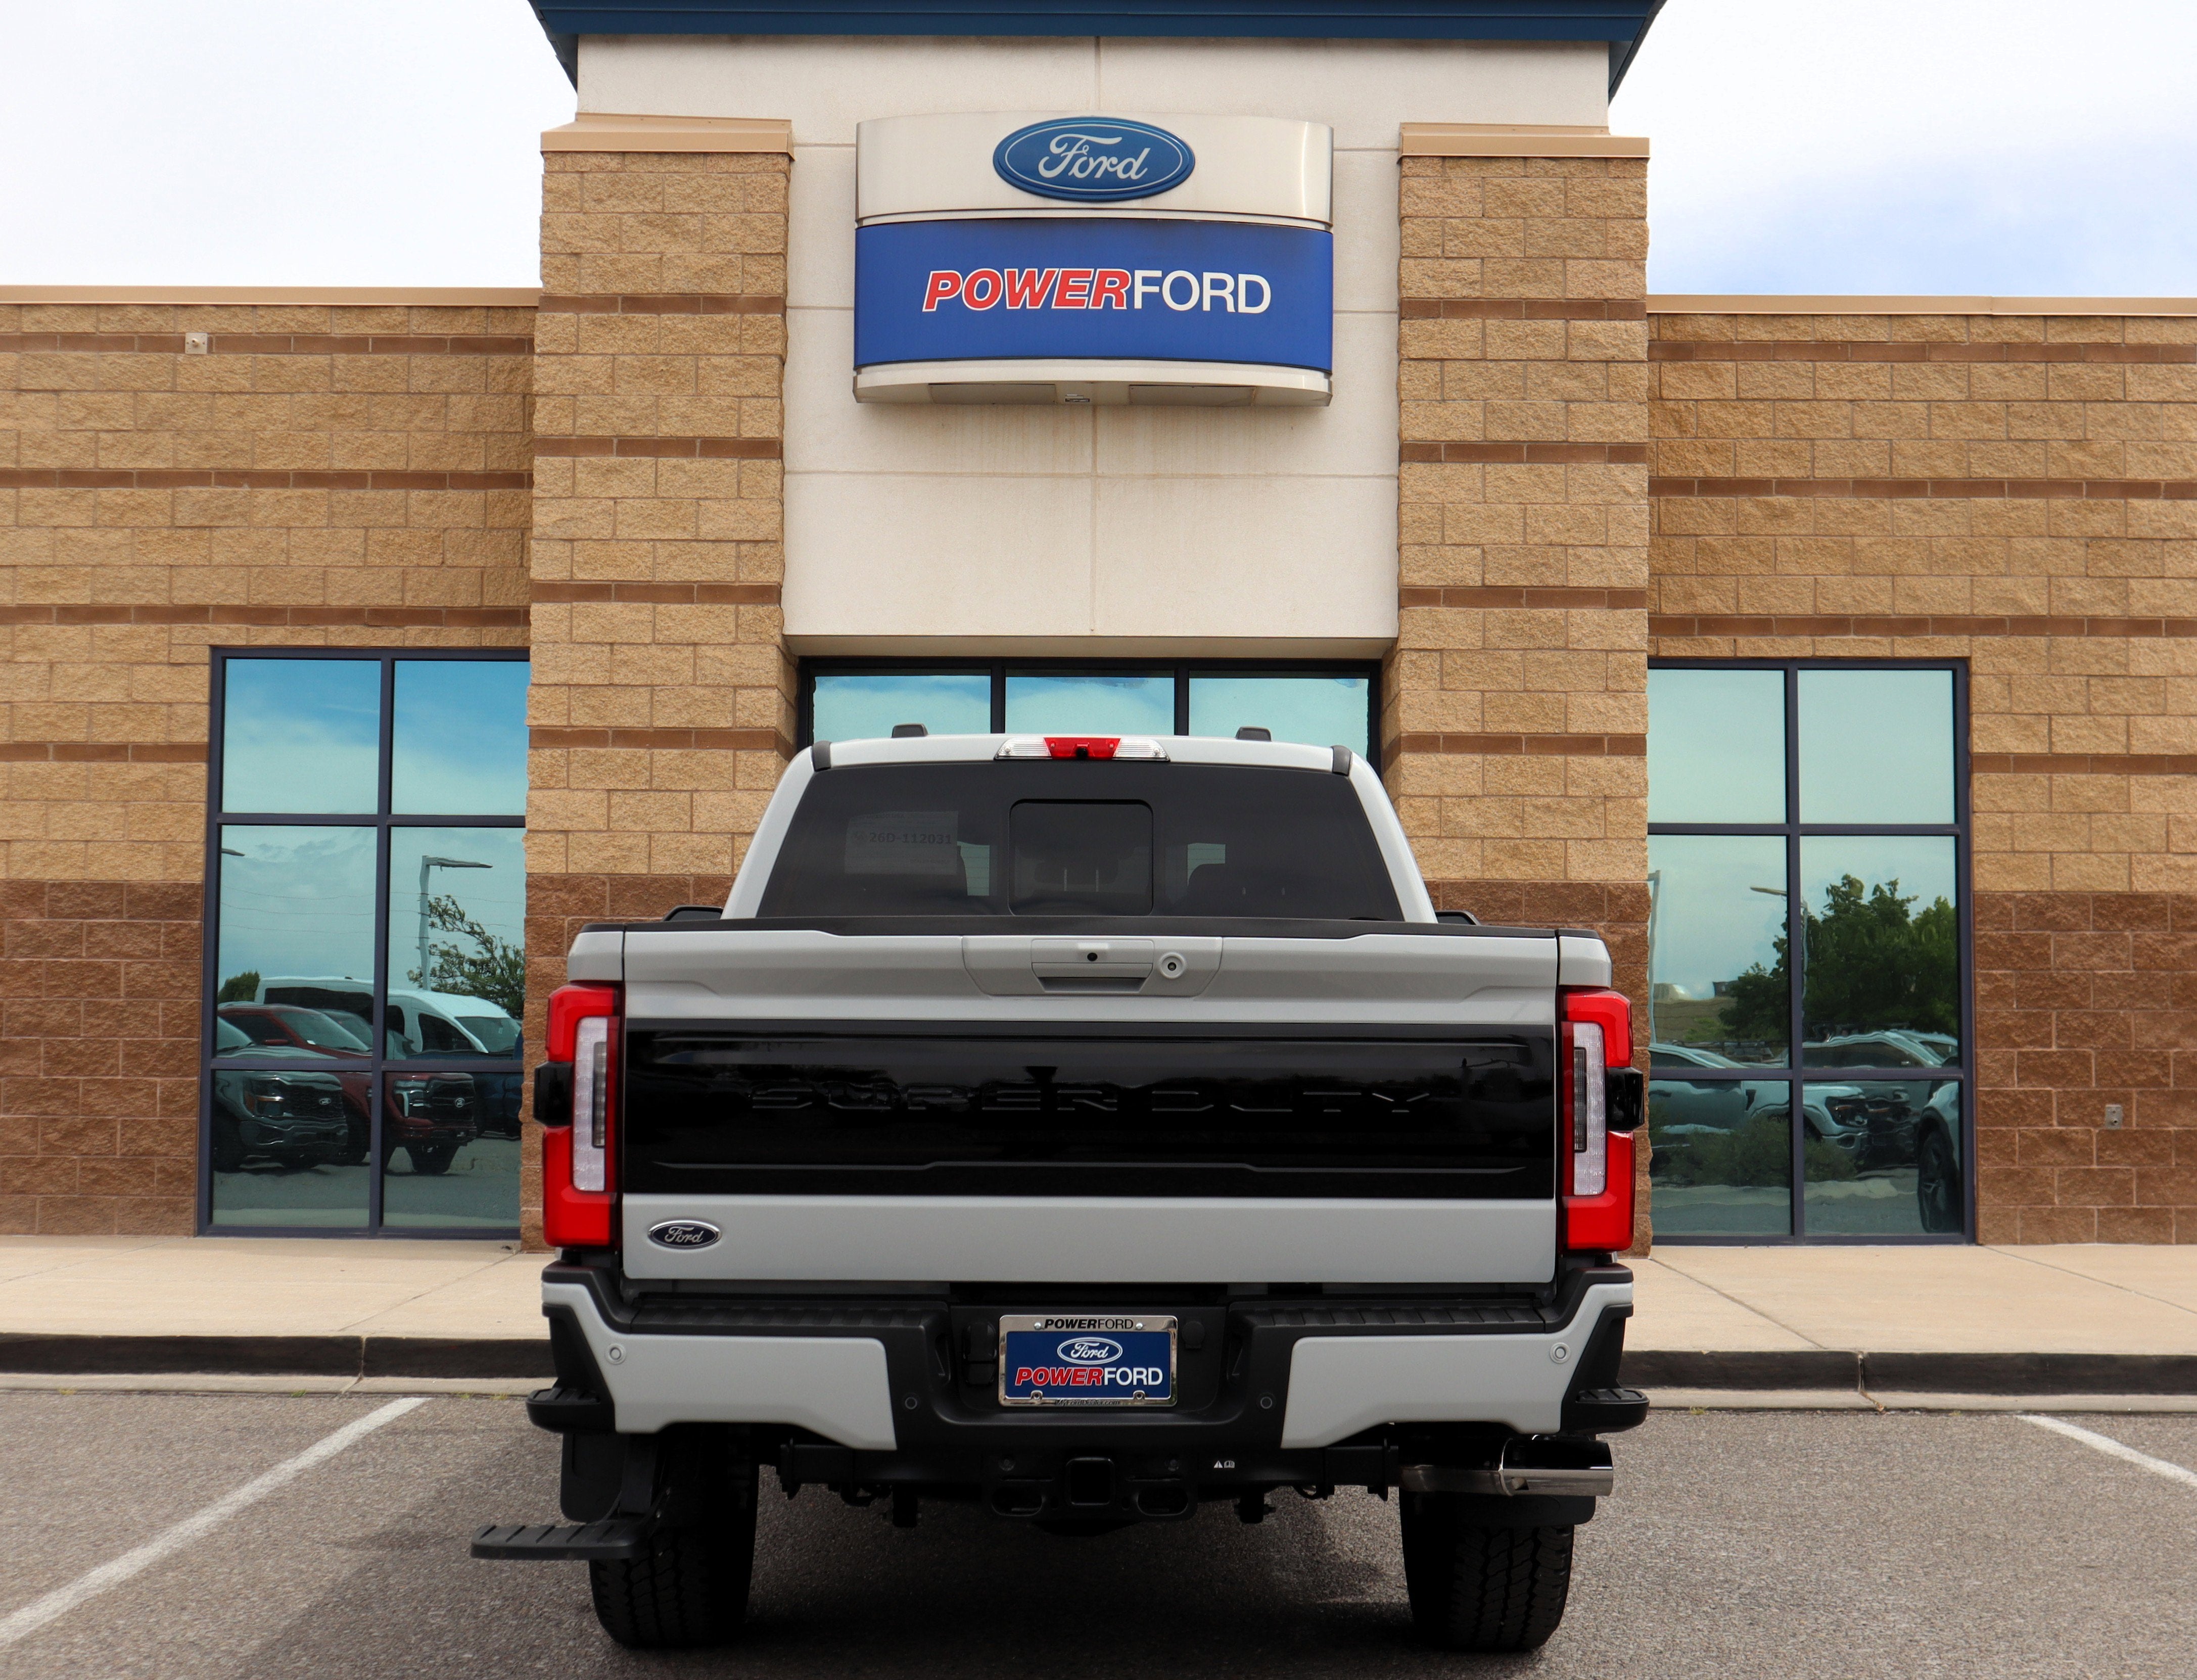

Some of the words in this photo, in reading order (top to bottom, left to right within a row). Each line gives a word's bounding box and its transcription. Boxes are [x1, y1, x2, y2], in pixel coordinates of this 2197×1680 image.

[1038, 132, 1151, 181] Ford
[922, 267, 1272, 314] POWERFORD
[869, 833, 952, 844] 26D-112031
[664, 1226, 704, 1242] Ford
[1044, 1318, 1134, 1329] POWERFORD
[1070, 1342, 1109, 1359] Ford
[1014, 1367, 1163, 1386] POWERFORD
